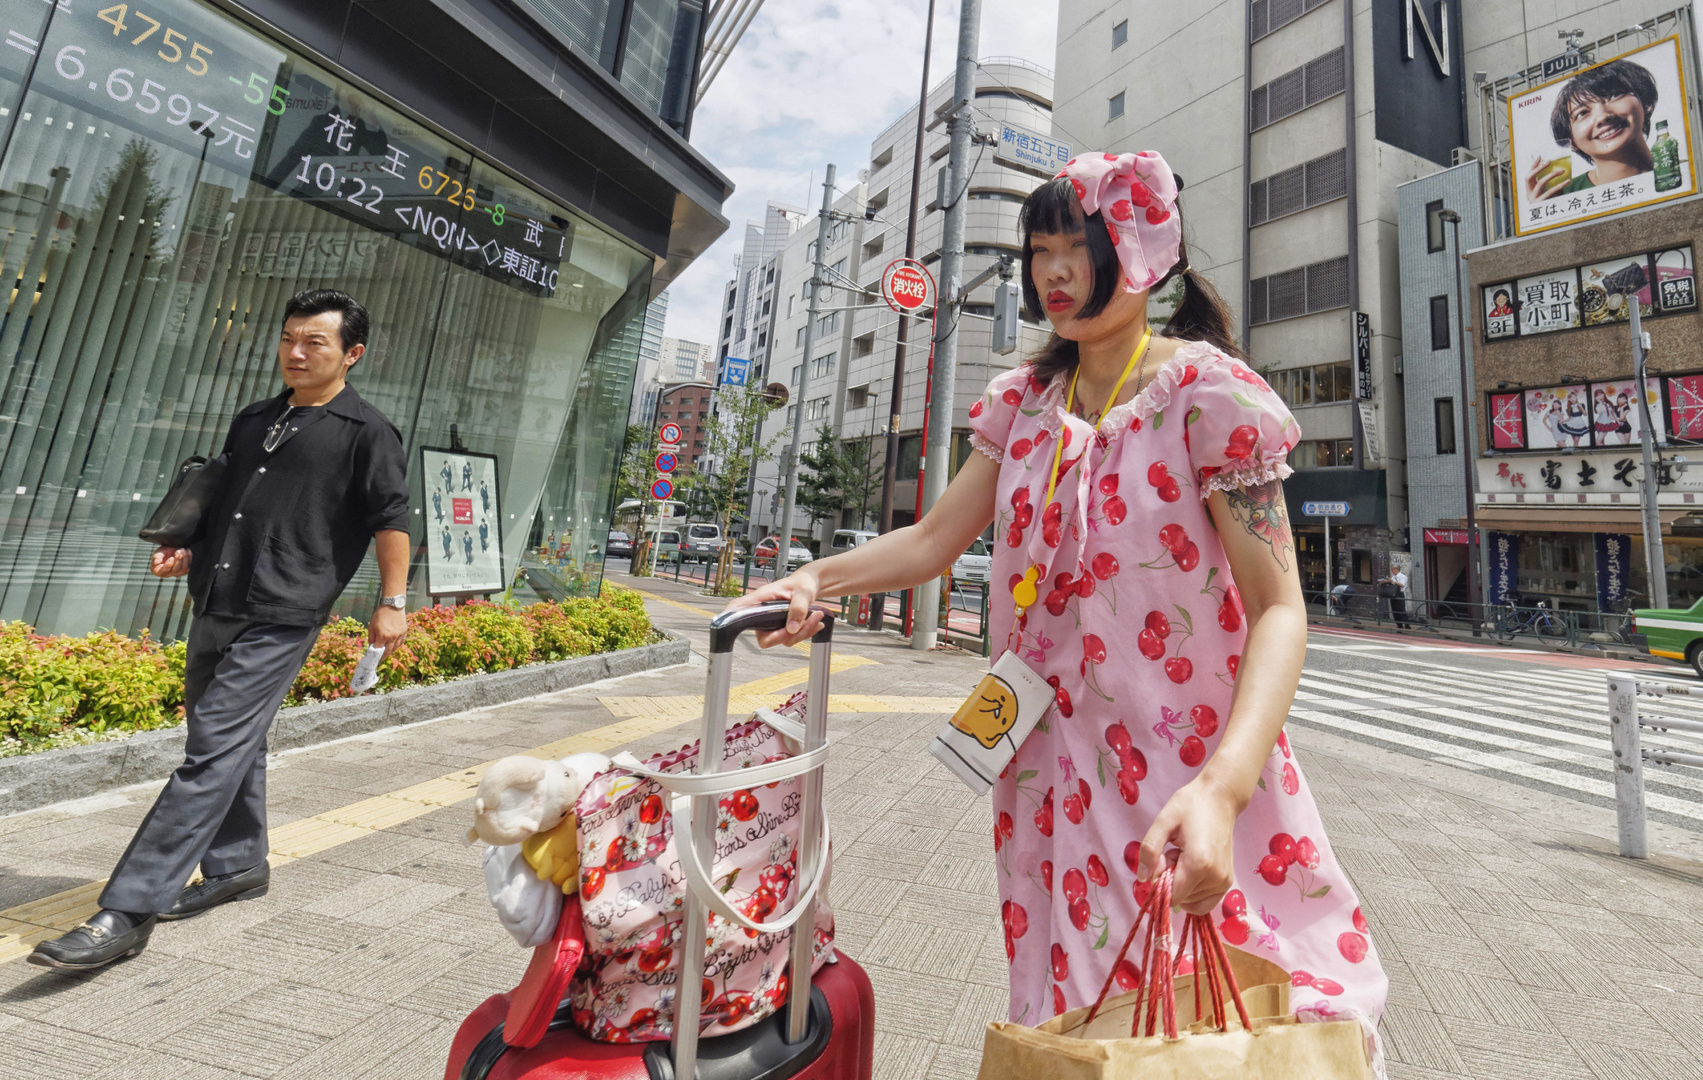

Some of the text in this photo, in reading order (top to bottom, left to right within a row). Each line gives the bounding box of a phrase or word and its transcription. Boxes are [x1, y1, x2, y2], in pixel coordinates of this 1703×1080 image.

[1406, 0, 1451, 77] N
[1518, 95, 1542, 108] KIRIN
[97, 4, 213, 76] 4755
[229, 72, 290, 116] -55
[484, 203, 506, 225] -8
[1002, 127, 1069, 162] 新宿五丁目
[1015, 148, 1055, 168] Shinjuku 5
[296, 154, 384, 215] 10:22
[1529, 183, 1645, 221] 夏は、冷え生茶。
[893, 277, 925, 299] 消火栓
[1525, 281, 1571, 306] 買取
[1664, 280, 1690, 294] 免税
[1666, 291, 1688, 300] TAX
[1667, 297, 1690, 306] FREE
[1490, 318, 1512, 334] 3F
[1527, 302, 1572, 327] 小町
[1358, 314, 1369, 357] シルバー
[1496, 462, 1527, 488] 名代
[702, 950, 757, 980] Bright
